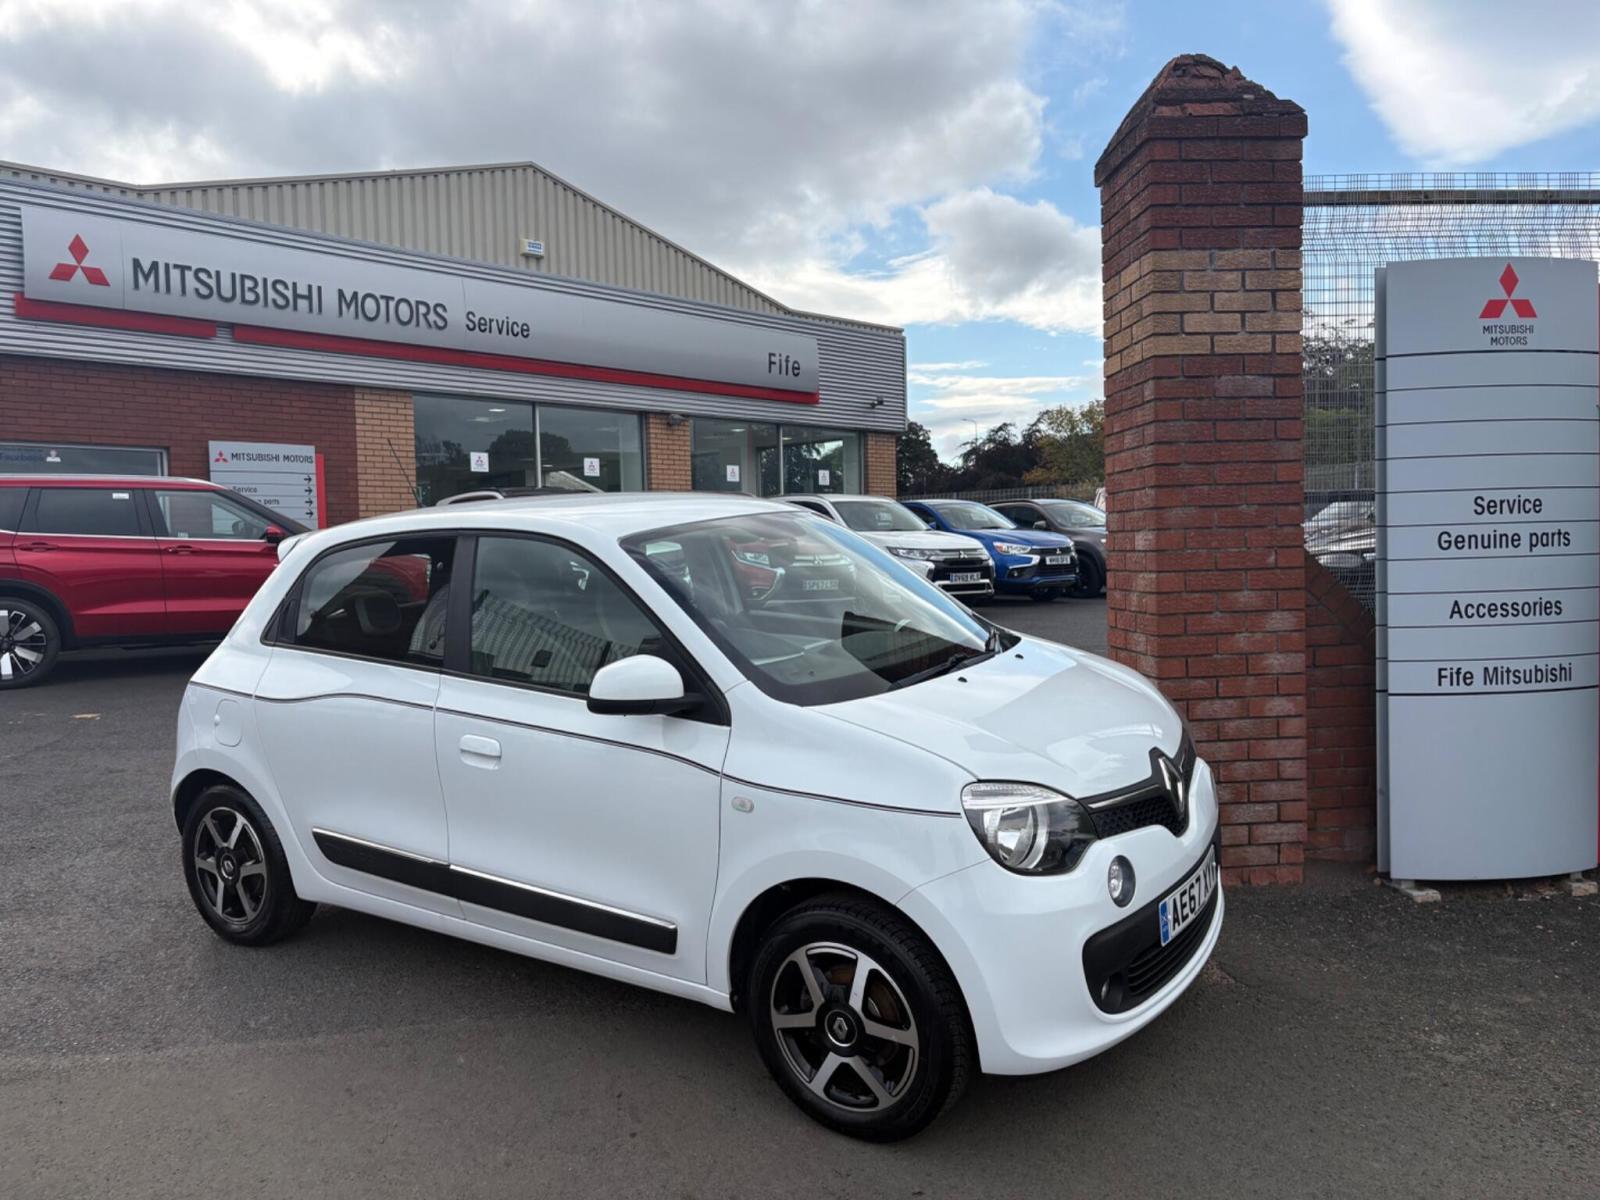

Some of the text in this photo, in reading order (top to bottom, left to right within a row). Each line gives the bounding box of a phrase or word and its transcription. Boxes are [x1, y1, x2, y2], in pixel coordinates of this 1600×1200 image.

[132, 257, 531, 338] MITSUBISHI MOTORS Service
[1482, 324, 1534, 335] MITSUBISHI
[1490, 335, 1528, 346] MOTORS
[768, 352, 801, 377] Fife
[231, 452, 314, 464] MITSUBISHI MOTORS
[1473, 494, 1543, 516] Service
[1437, 528, 1572, 552] Genuine parts
[1449, 597, 1563, 620] Accessories
[1437, 662, 1573, 687] Fife Mitsubishi
[1172, 874, 1201, 931] AE67
